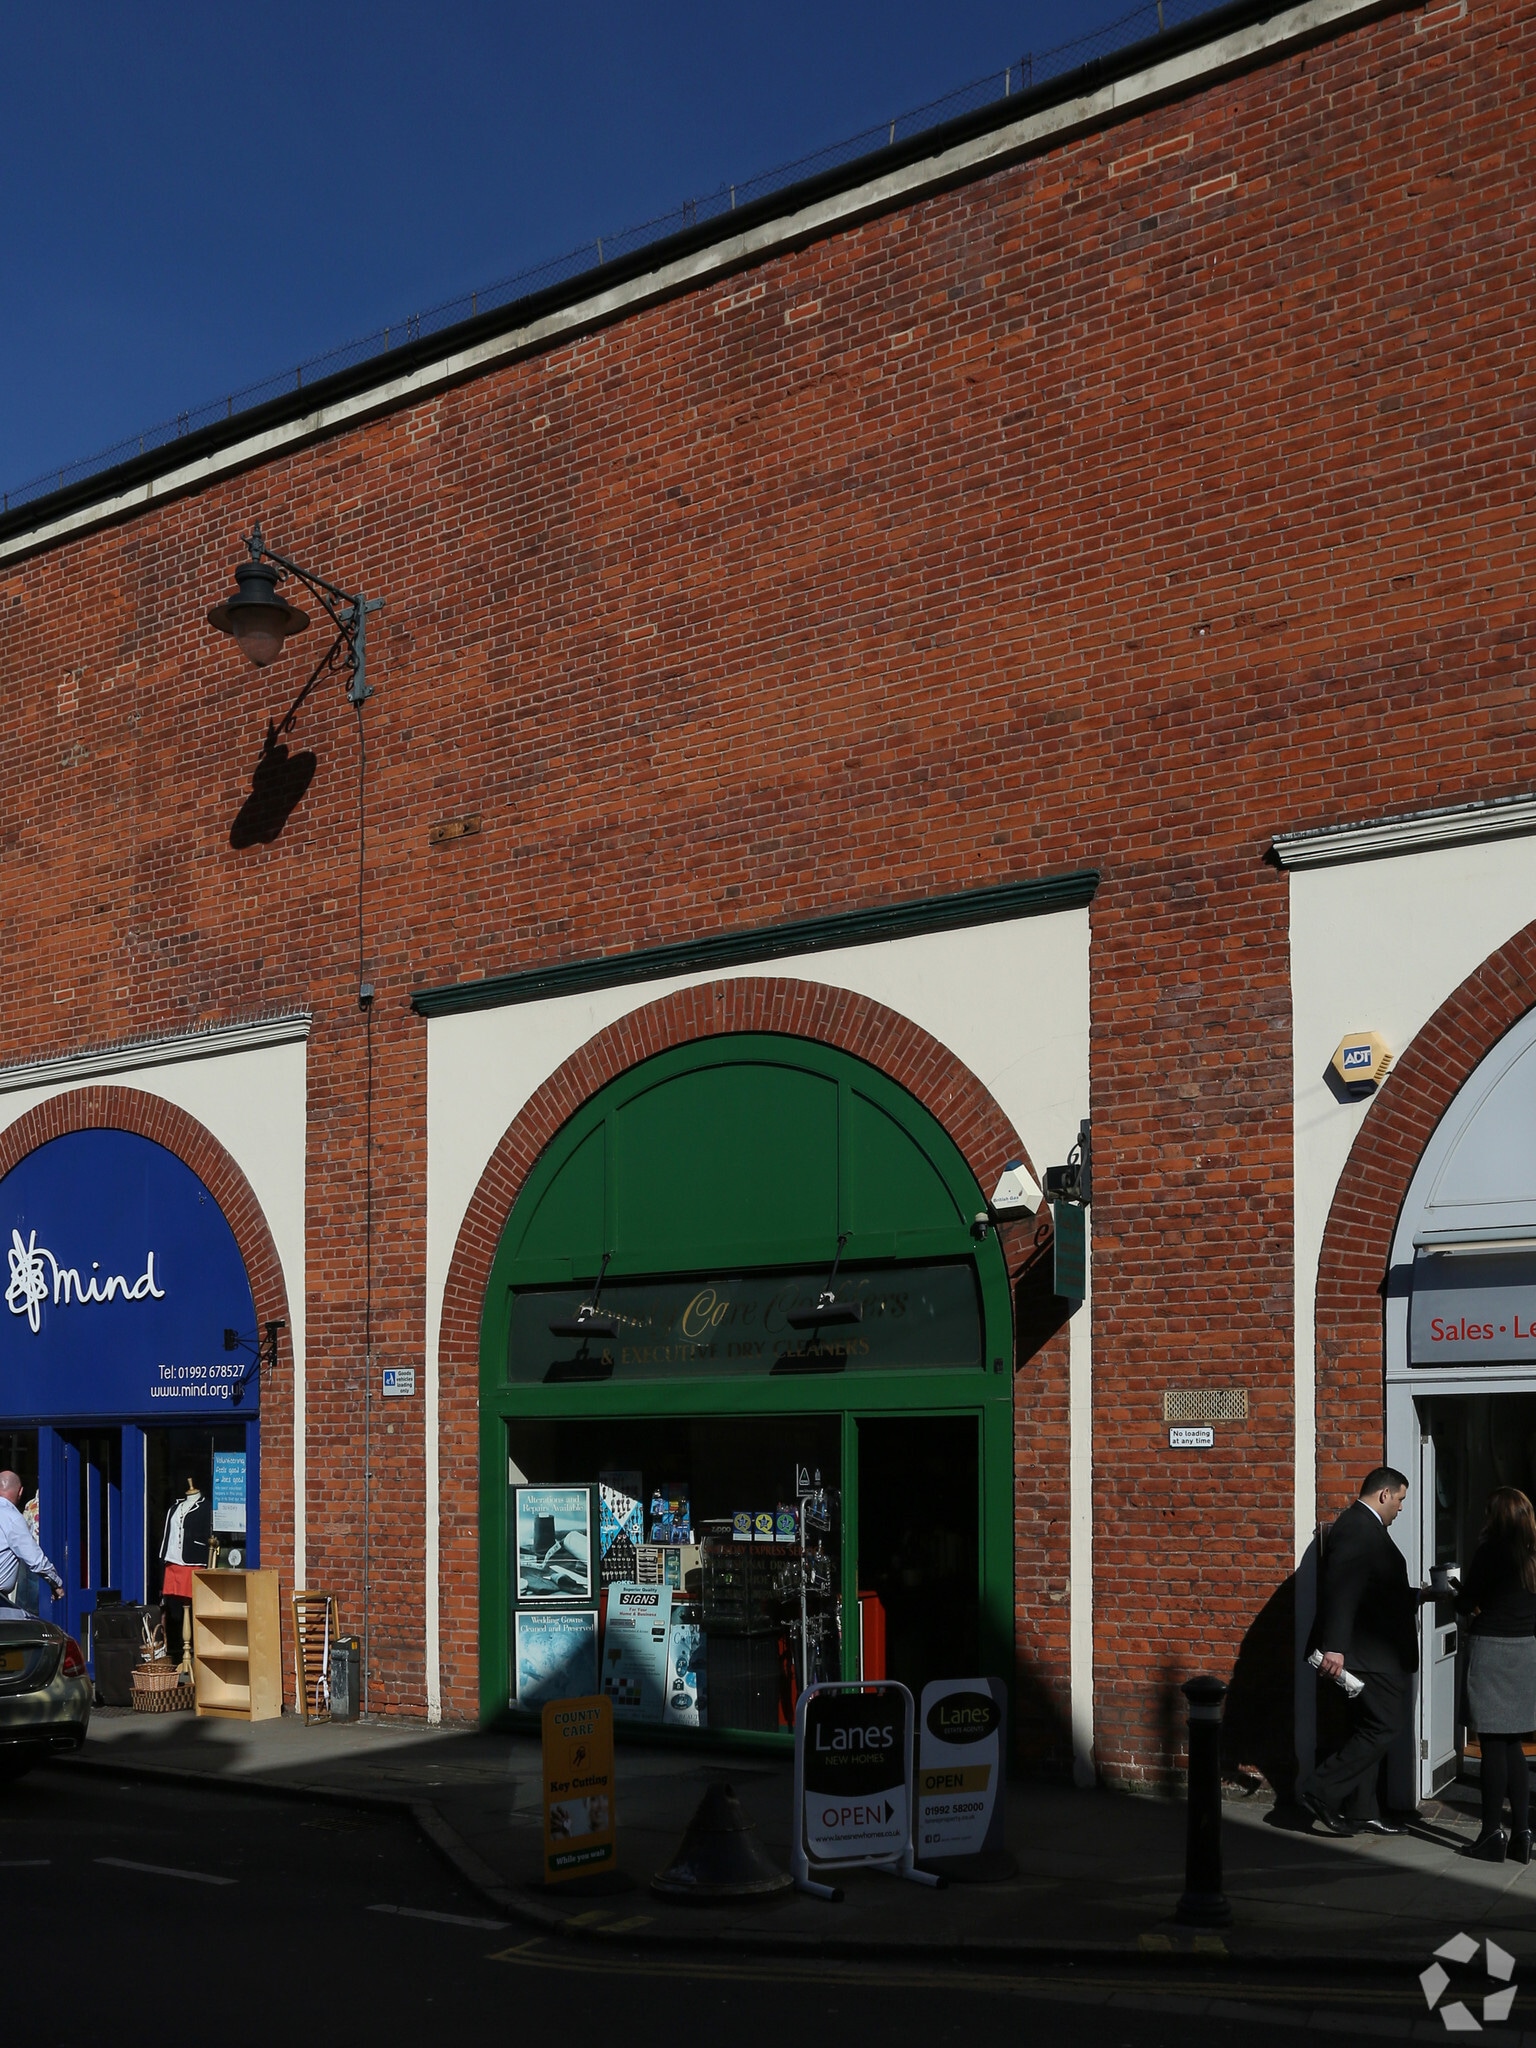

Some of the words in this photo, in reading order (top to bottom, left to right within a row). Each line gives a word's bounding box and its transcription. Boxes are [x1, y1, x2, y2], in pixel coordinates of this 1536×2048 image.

[1344, 1050, 1371, 1066] ADT
[51, 1250, 165, 1304] mind
[1430, 1317, 1494, 1341] Sales
[601, 1347, 613, 1365] &
[622, 1342, 719, 1365] EXECUTIVE
[727, 1340, 766, 1360] DRY
[773, 1335, 870, 1359] CLEANERS
[158, 1364, 177, 1379] Tel:
[178, 1366, 207, 1379] 01992
[209, 1364, 245, 1378] 678527
[1185, 1430, 1210, 1438] loading
[527, 1495, 563, 1504] Alterations
[565, 1495, 580, 1503] and
[523, 1504, 549, 1514] Repairs
[553, 1504, 583, 1512] Available
[749, 1545, 787, 1557] EXPRESS
[622, 1594, 656, 1604] SIGNS
[531, 1616, 560, 1625] Wedding
[548, 1624, 561, 1632] and
[563, 1624, 594, 1632] Preserved
[554, 1708, 601, 1725] COUNTY
[940, 1706, 990, 1725] Lanes
[562, 1723, 594, 1738] CARE
[815, 1722, 894, 1751] Lanes
[825, 1755, 848, 1766] NEW
[851, 1753, 885, 1764] HOMES
[550, 1780, 570, 1793] Key
[572, 1775, 608, 1788] Cutting
[926, 1774, 964, 1790] OPEN
[822, 1805, 881, 1827] OPEN
[925, 1805, 950, 1815] 01992
[952, 1802, 984, 1813] 582000
[815, 1829, 901, 1842] www.lanesnewhomes.co.uk
[556, 1854, 576, 1866] While
[577, 1853, 588, 1863] you
[588, 1848, 605, 1860] wait
